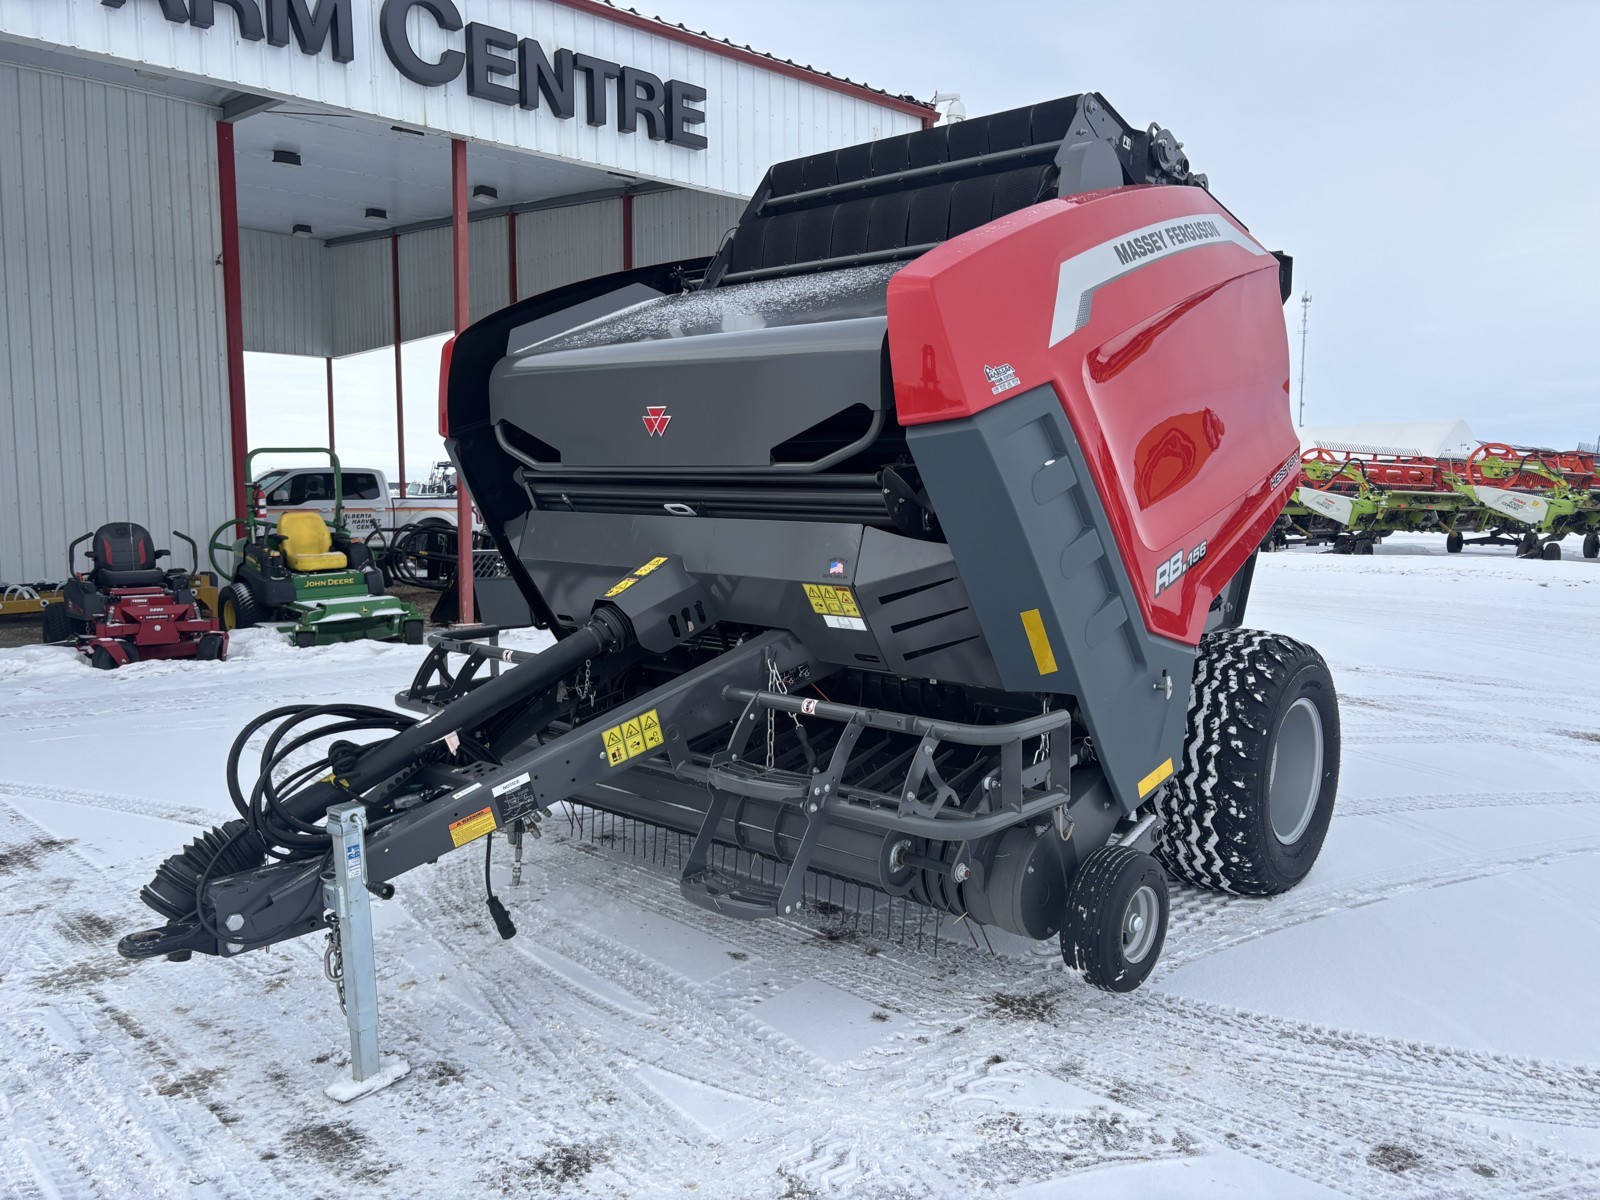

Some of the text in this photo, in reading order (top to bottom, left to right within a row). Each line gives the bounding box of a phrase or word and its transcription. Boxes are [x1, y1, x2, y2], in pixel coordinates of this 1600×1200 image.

[380, 0, 708, 150] CENTRE
[1113, 220, 1221, 266] MASSEY FERGUSON
[1270, 450, 1299, 491] HESSTON
[304, 577, 355, 588] JOHN DEERE
[502, 779, 520, 791] NOTICE
[462, 810, 485, 824] WARNING
